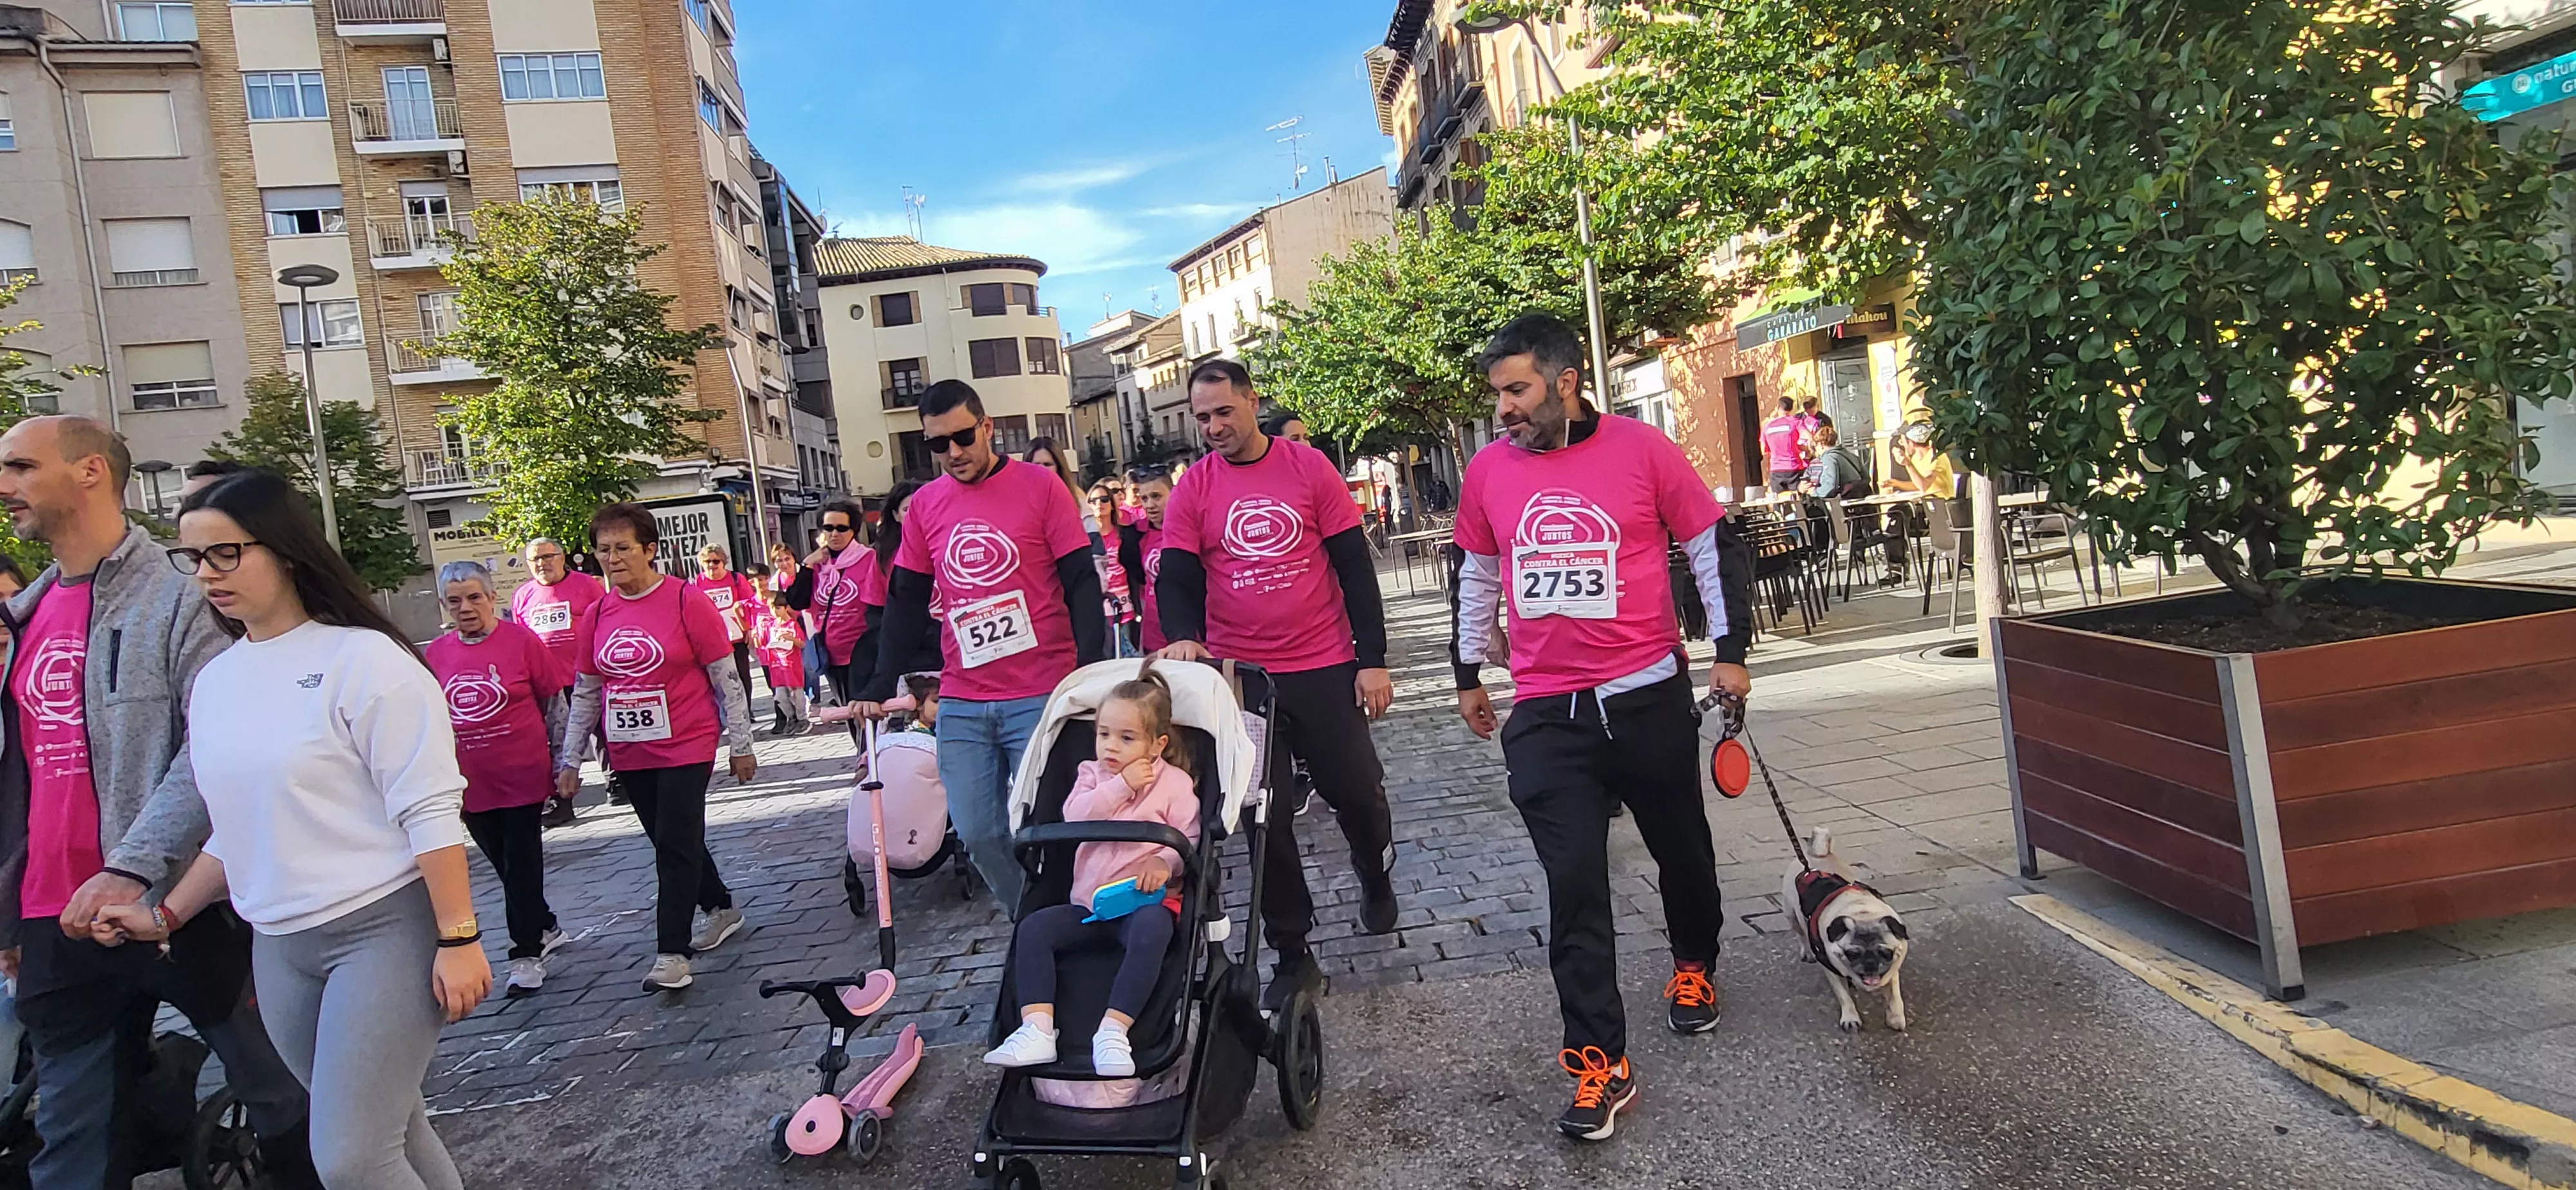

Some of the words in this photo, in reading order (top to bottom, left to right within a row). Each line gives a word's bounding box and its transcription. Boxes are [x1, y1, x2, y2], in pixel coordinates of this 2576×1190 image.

[2561, 79, 2576, 93] G
[657, 512, 710, 538] MEJOR
[1542, 532, 1572, 541] JUNTOS
[655, 534, 708, 560] RVEZA
[1524, 559, 1558, 568] CONTRA
[1559, 558, 1568, 566] EL
[1569, 556, 1604, 565] CÁNCER
[1524, 569, 1605, 599] 2753
[712, 594, 730, 603] 874
[534, 612, 565, 627] 2869
[969, 616, 1018, 648] 522
[616, 710, 654, 728] 538
